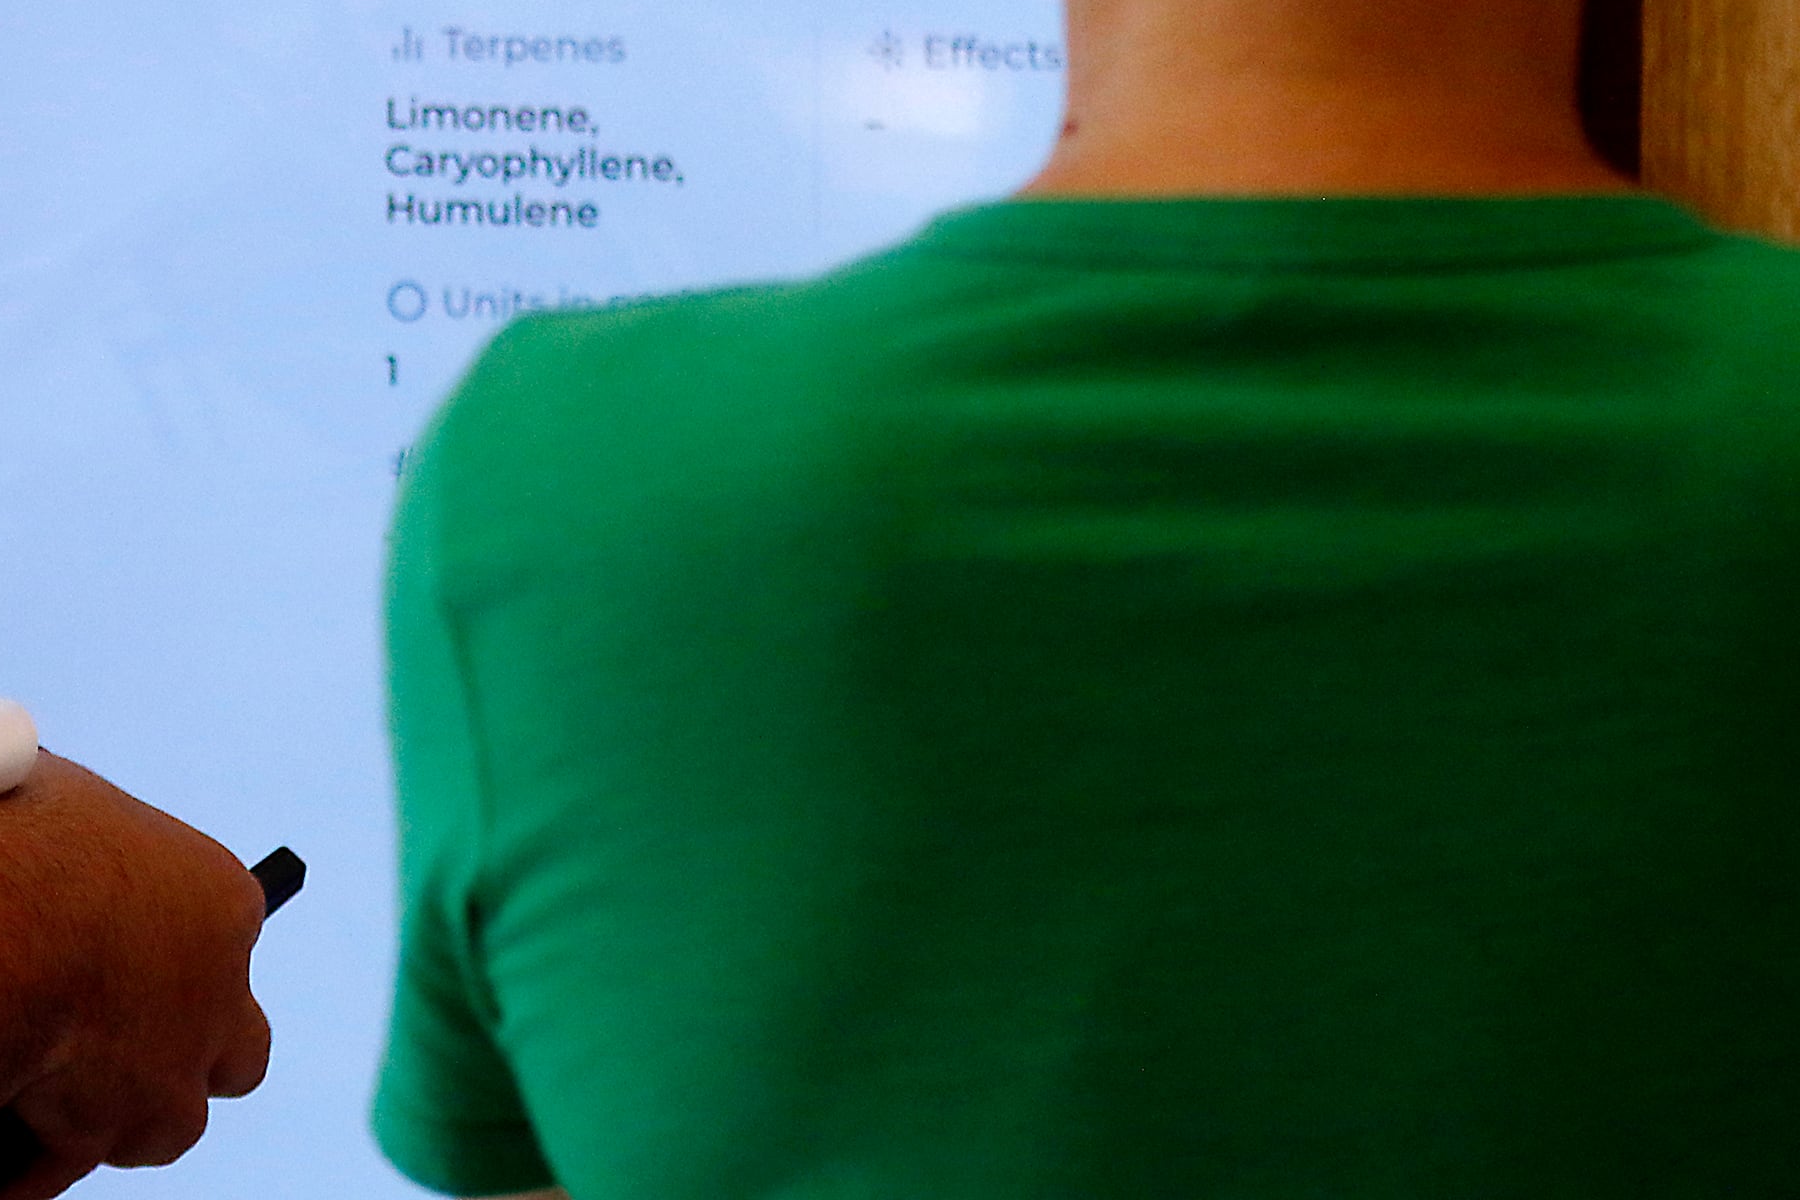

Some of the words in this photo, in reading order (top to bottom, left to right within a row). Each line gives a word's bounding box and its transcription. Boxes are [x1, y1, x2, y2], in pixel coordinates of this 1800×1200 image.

[441, 25, 628, 69] Terpenes
[923, 33, 1062, 72] Effects
[386, 97, 600, 137] Limonene,
[383, 143, 686, 188] Caryophyllene,
[386, 192, 600, 229] Humulene
